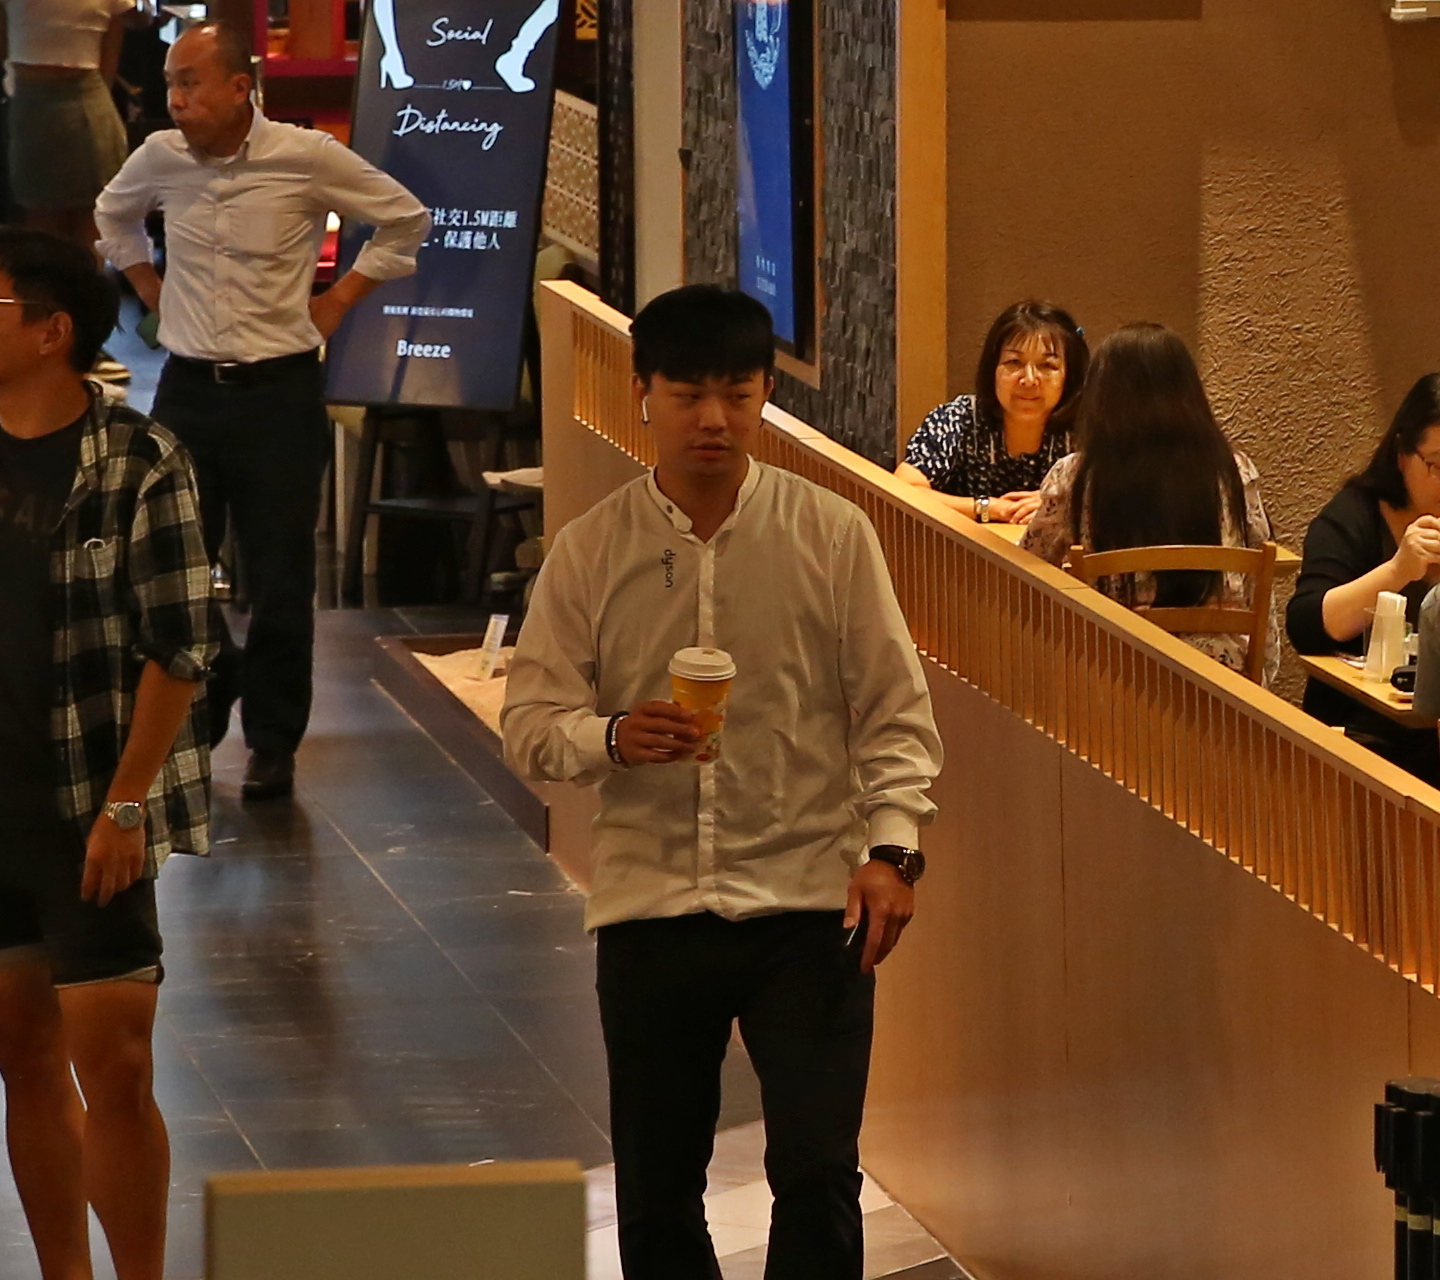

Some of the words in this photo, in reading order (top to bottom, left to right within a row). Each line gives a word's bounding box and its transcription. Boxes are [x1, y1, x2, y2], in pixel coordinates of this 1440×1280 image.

[426, 17, 493, 47] Social
[392, 104, 505, 151] Distancing
[426, 207, 518, 229] 社交1.5M距離
[395, 339, 452, 359] Breeze
[661, 549, 677, 588] dyson
